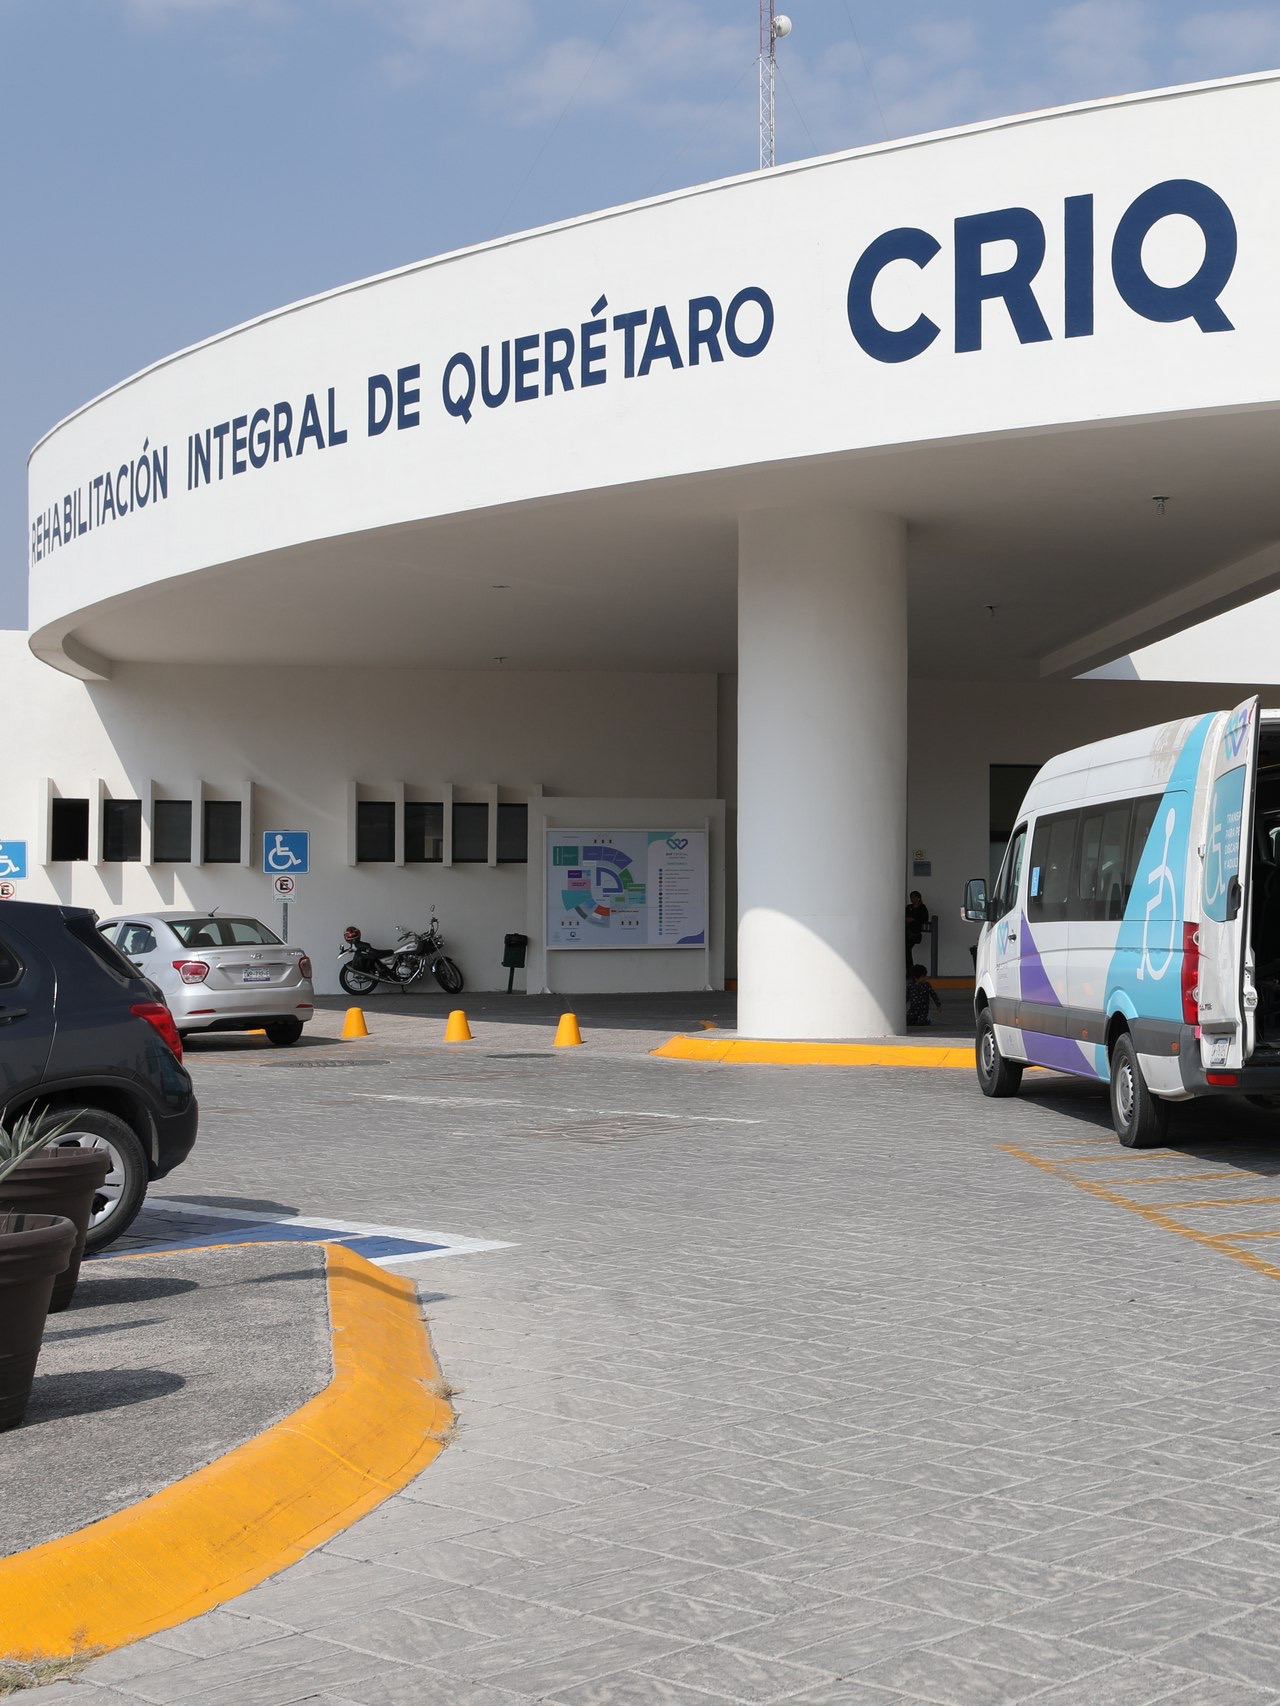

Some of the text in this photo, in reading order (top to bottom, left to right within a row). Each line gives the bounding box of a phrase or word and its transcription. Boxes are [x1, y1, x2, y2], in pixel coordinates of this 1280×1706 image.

[847, 178, 1237, 364] CRIQ
[32, 286, 775, 568] REHABILITACIÓN INTEGRAL DE QUERÉTARO
